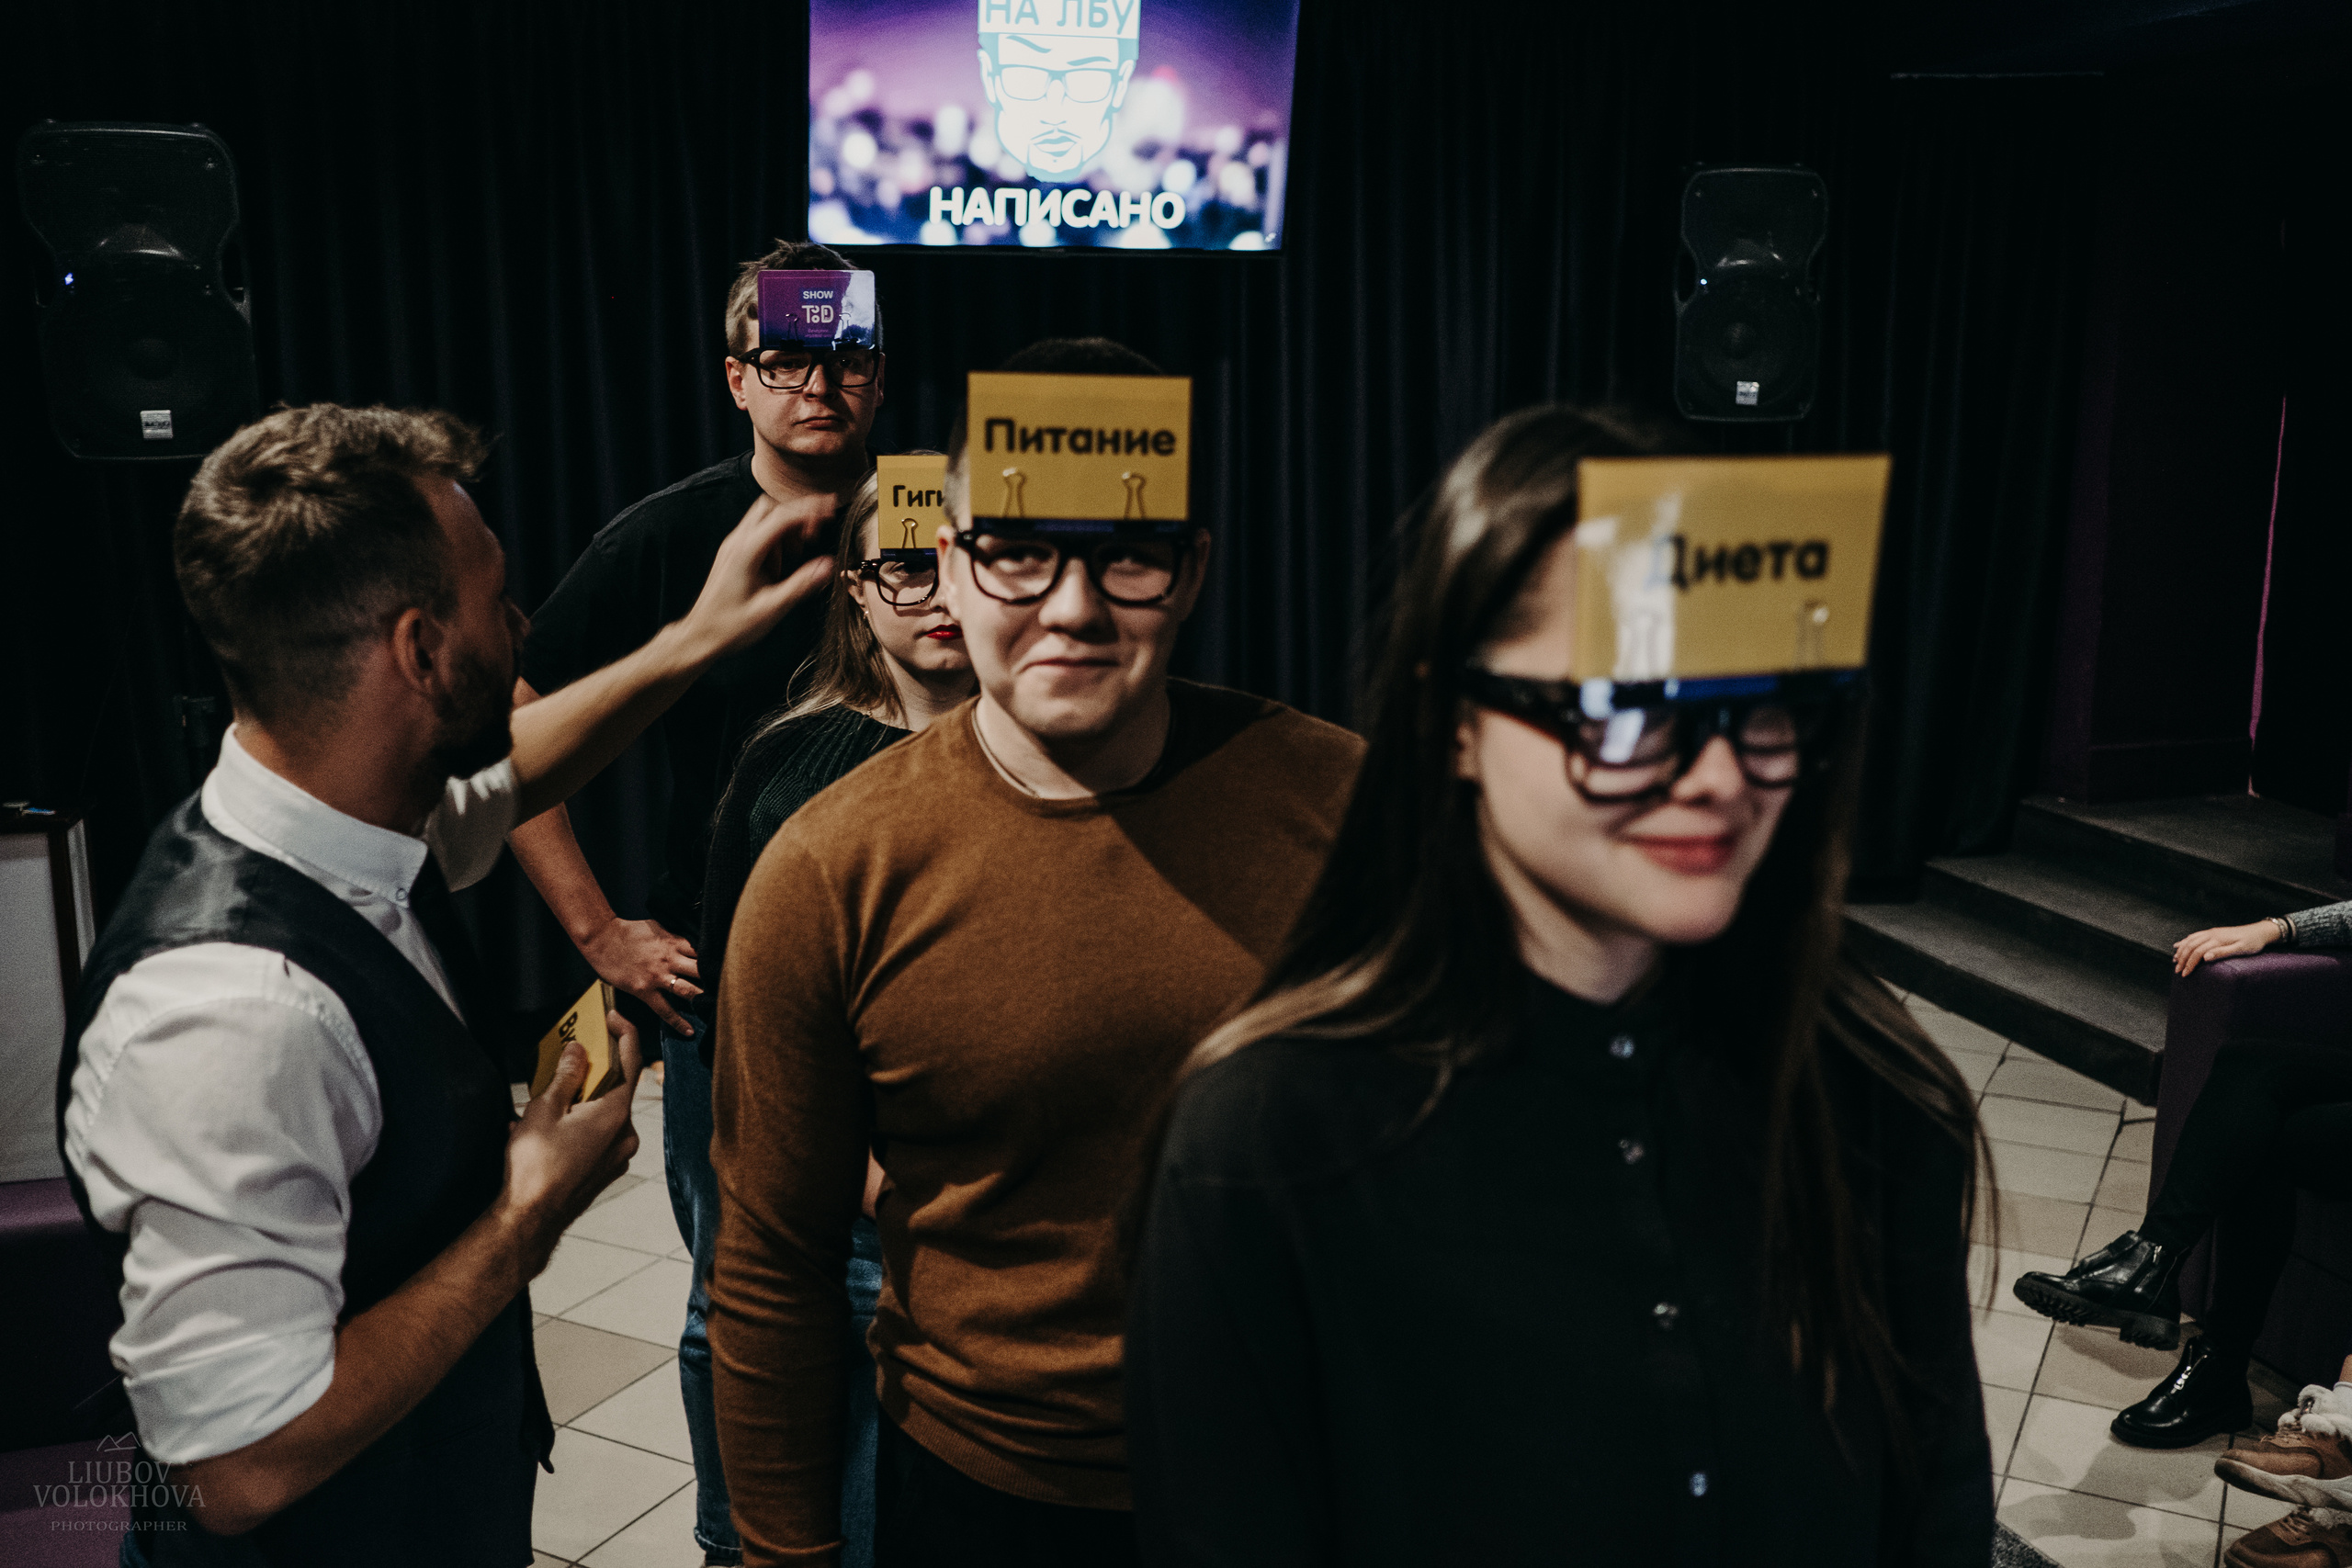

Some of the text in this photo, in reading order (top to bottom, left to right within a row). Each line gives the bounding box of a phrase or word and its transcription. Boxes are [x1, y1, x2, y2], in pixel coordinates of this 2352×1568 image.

[985, 0, 1135, 36] НА ЛБУ
[929, 186, 1185, 230] НАПИСАНО
[802, 290, 834, 299] SHOW
[985, 417, 1177, 457] Питание
